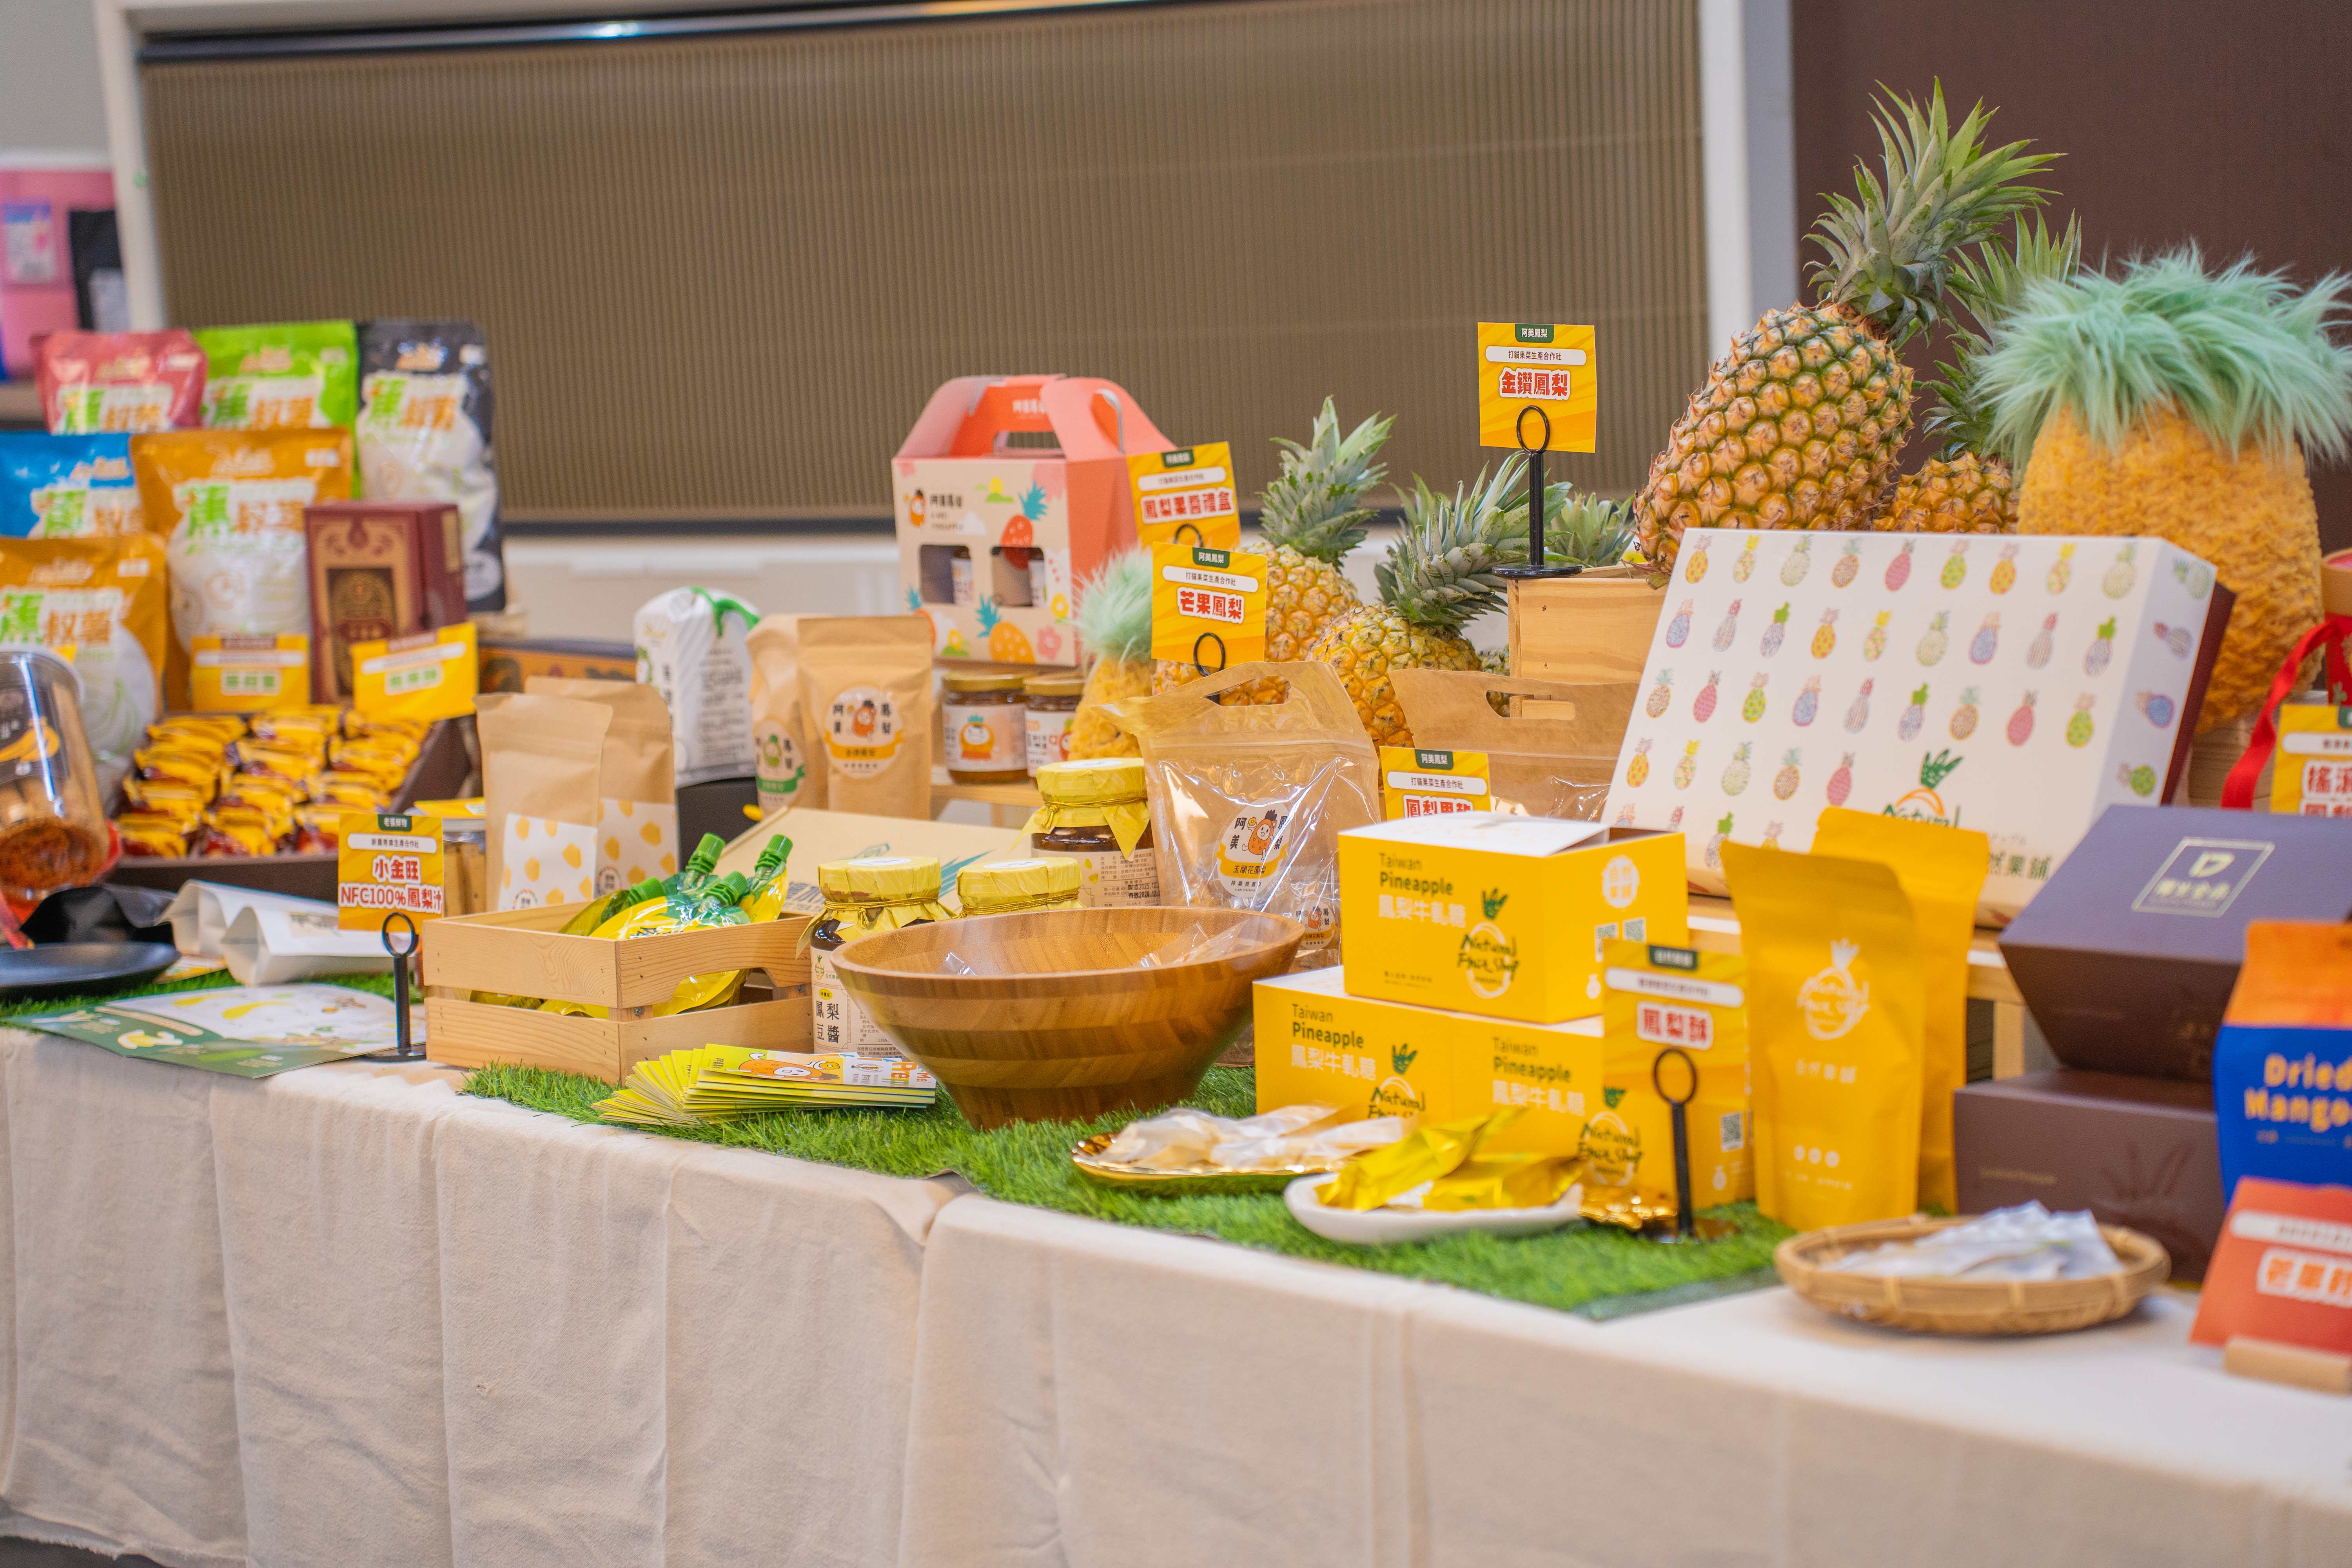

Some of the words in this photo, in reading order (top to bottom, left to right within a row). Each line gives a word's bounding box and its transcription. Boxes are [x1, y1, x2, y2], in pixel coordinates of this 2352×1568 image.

[1522, 328, 1548, 338] 阿美鳳梨
[1508, 350, 1562, 361] 打貓果菜生產合作社
[1501, 371, 1568, 397] 金鑽鳳梨
[1198, 552, 1224, 564] 阿美鳳梨
[1185, 572, 1236, 586] 打貓果菜生產合作社
[1180, 590, 1242, 620] 芒果鳳梨
[1421, 753, 1448, 765] 阿美鳳梨
[374, 858, 419, 881] 小金旺
[1379, 853, 1422, 871] Taiwan
[1379, 871, 1453, 896] Pineapple
[341, 886, 442, 910] NFC100%鳳梨汁
[1378, 894, 1466, 928] 鳳梨牛軋糖
[1461, 934, 1517, 957] Natural
[816, 1000, 840, 1020] 鳳梨
[1292, 1004, 1333, 1023] Taiwan
[816, 1024, 840, 1044] 豆醬
[1292, 1022, 1364, 1049] Pineapple
[1493, 1036, 1538, 1056] Taiwan
[1291, 1044, 1376, 1081] 鳳梨牛軋糖
[1493, 1056, 1571, 1083] Pineapple
[1370, 1087, 1426, 1112] Natural
[1492, 1080, 1585, 1117] 鳳梨牛軋糖
